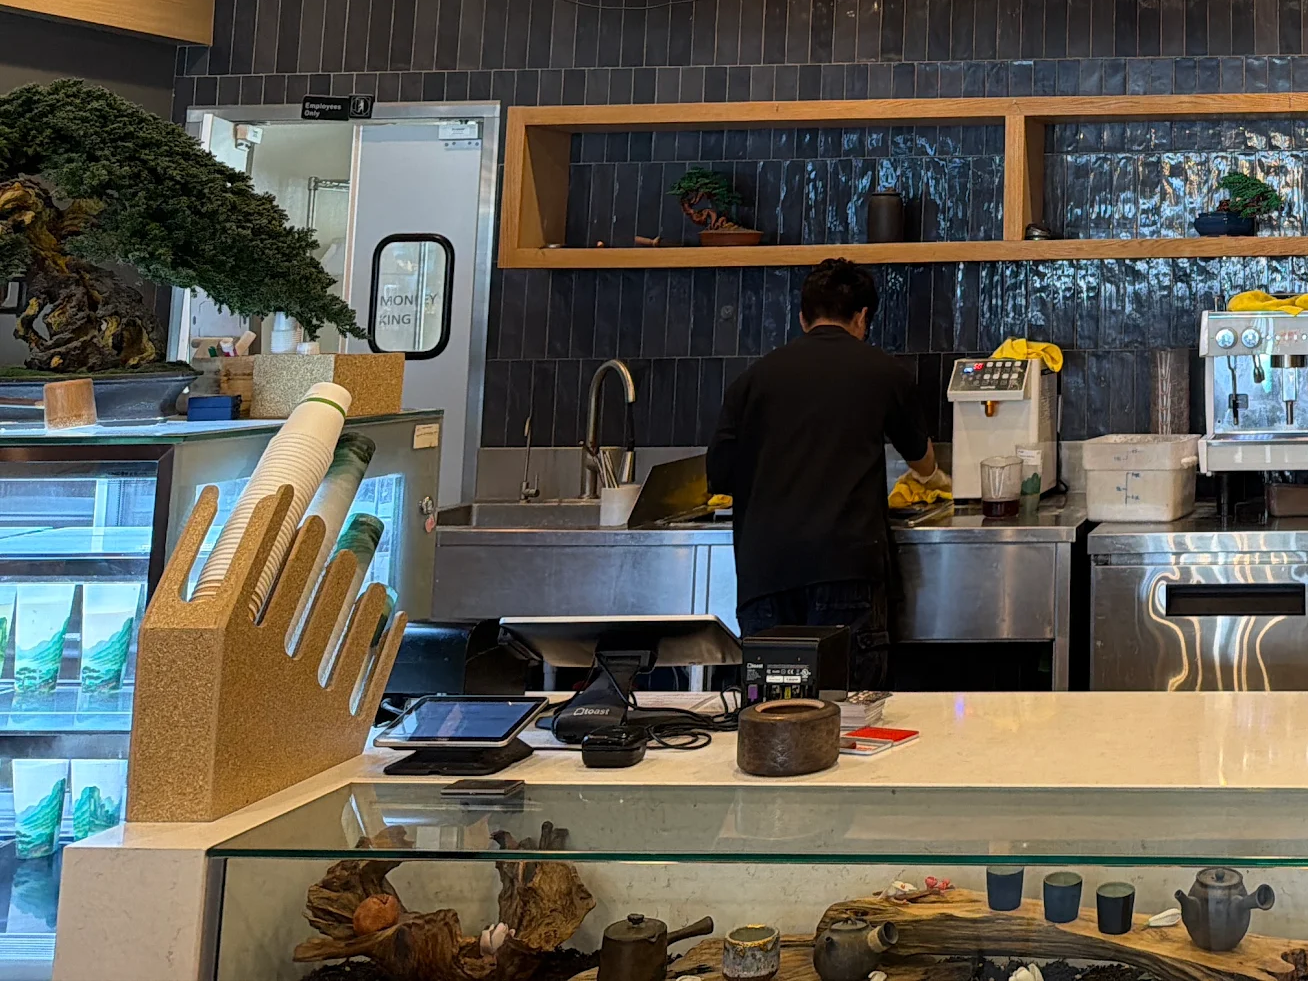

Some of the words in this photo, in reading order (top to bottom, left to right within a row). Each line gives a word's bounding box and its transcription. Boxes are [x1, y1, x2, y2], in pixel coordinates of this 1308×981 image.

[305, 102, 342, 111] Employees
[304, 110, 320, 118] Only
[380, 294, 438, 306] MONEY
[379, 314, 411, 325] KING
